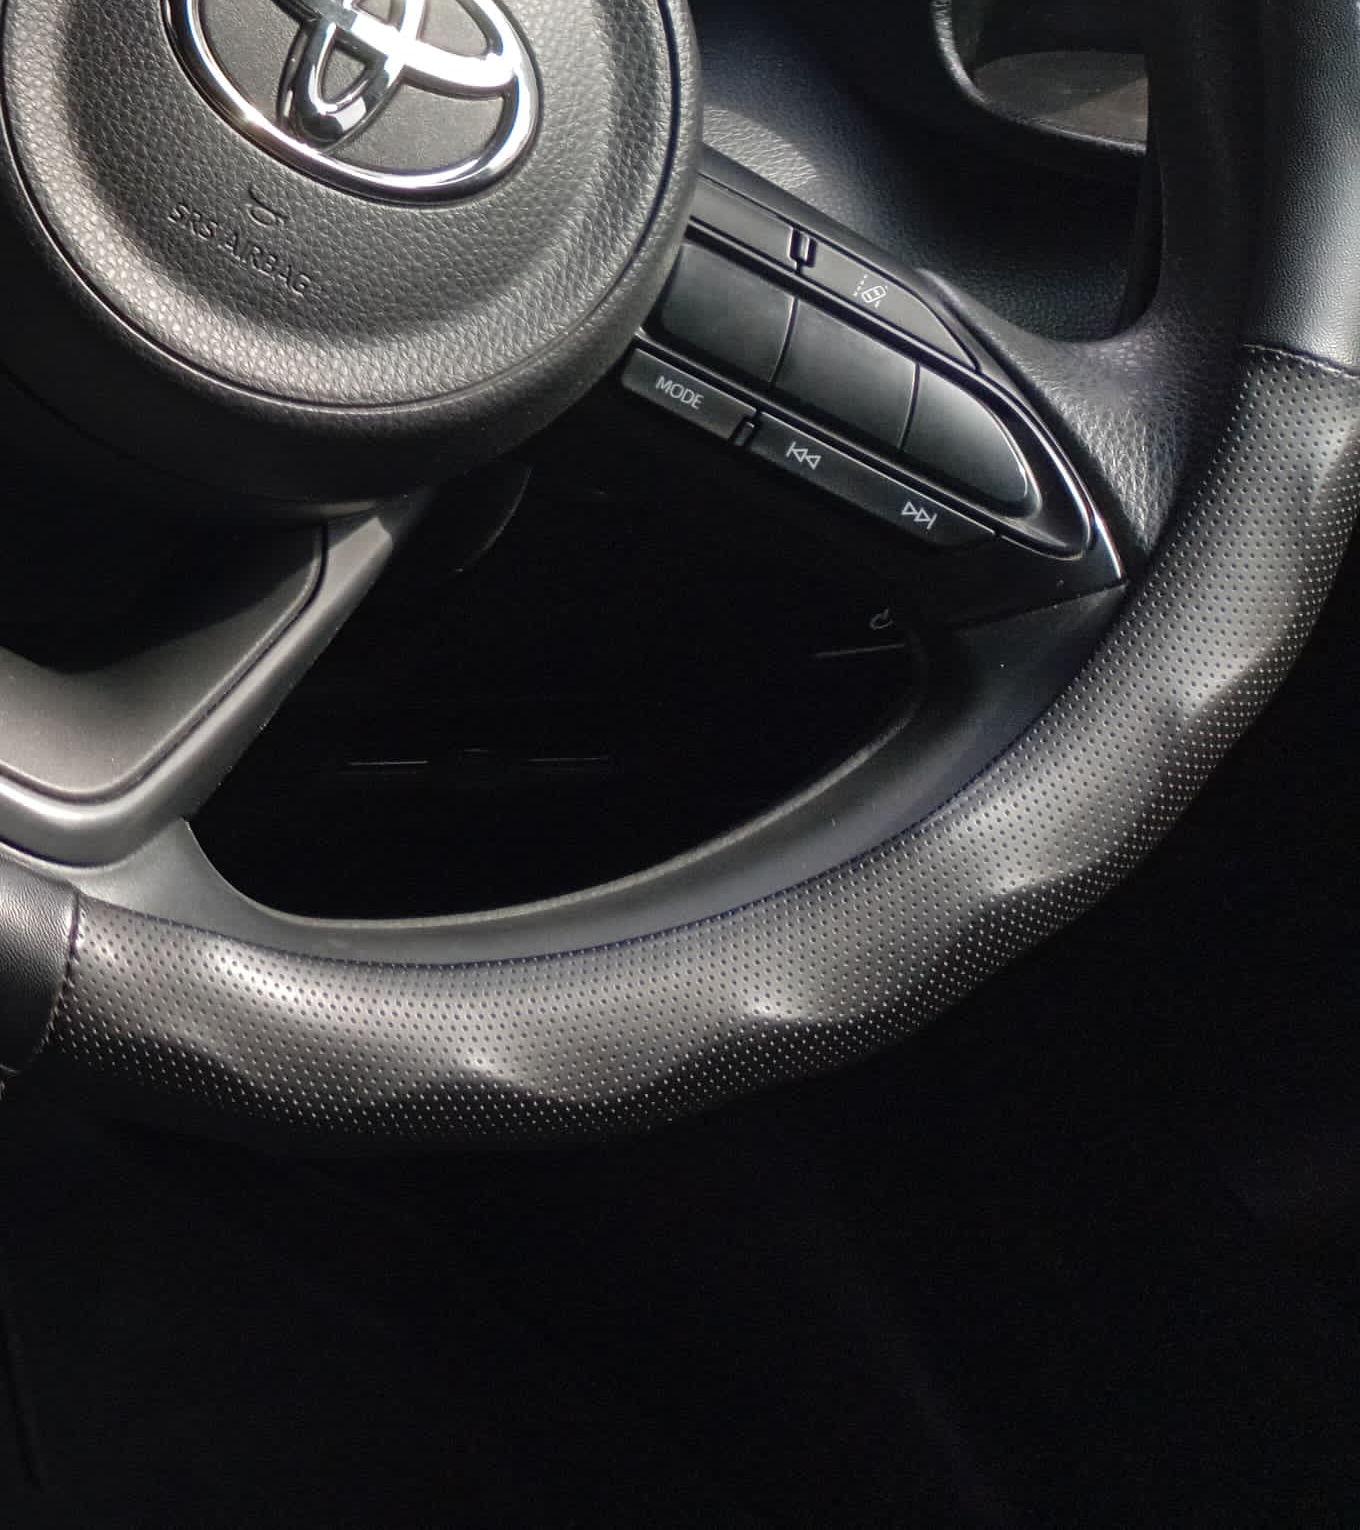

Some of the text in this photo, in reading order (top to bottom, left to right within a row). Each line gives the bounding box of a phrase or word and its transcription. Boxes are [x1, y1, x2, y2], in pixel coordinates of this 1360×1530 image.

[167, 202, 312, 299] SRS AIRBAG
[655, 375, 705, 410] MODE
